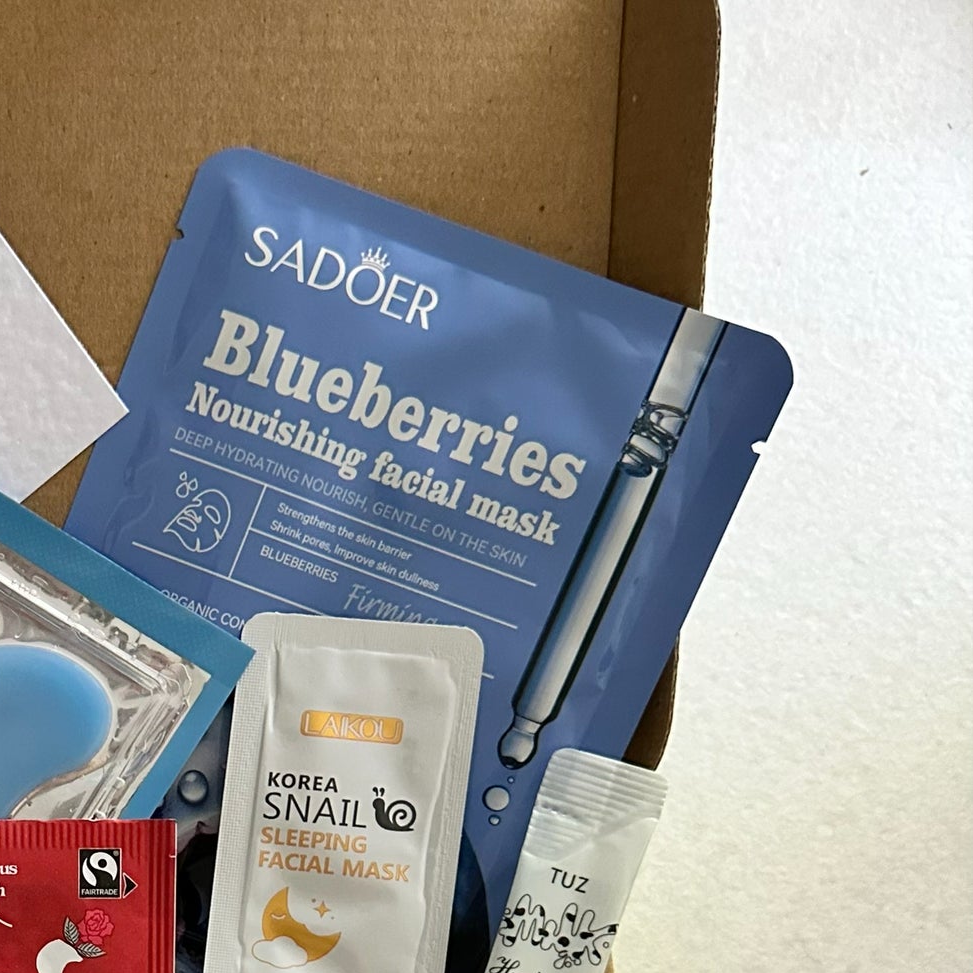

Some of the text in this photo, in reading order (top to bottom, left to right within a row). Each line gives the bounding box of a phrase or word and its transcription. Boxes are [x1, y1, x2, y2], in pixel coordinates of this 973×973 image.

[244, 227, 438, 330] SADOER
[203, 309, 586, 499] Blueberries
[186, 381, 560, 545] Nourishing facial mask
[174, 426, 527, 568] DEEP HYDRATING NOURISH, GENTLE ON THE SKIN
[277, 502, 412, 561] Strengthens the skin barrier
[260, 545, 339, 583] BLUEBERRIES
[270, 520, 439, 592] Shrink pores, Improve skin dullness
[268, 772, 338, 793] KOREA
[262, 792, 367, 828] SNAIL
[260, 826, 367, 854] SLEEPING
[258, 851, 410, 882] FACIAL MASK
[551, 867, 589, 893] TUZ
[81, 888, 118, 896] FAIRTRADE
